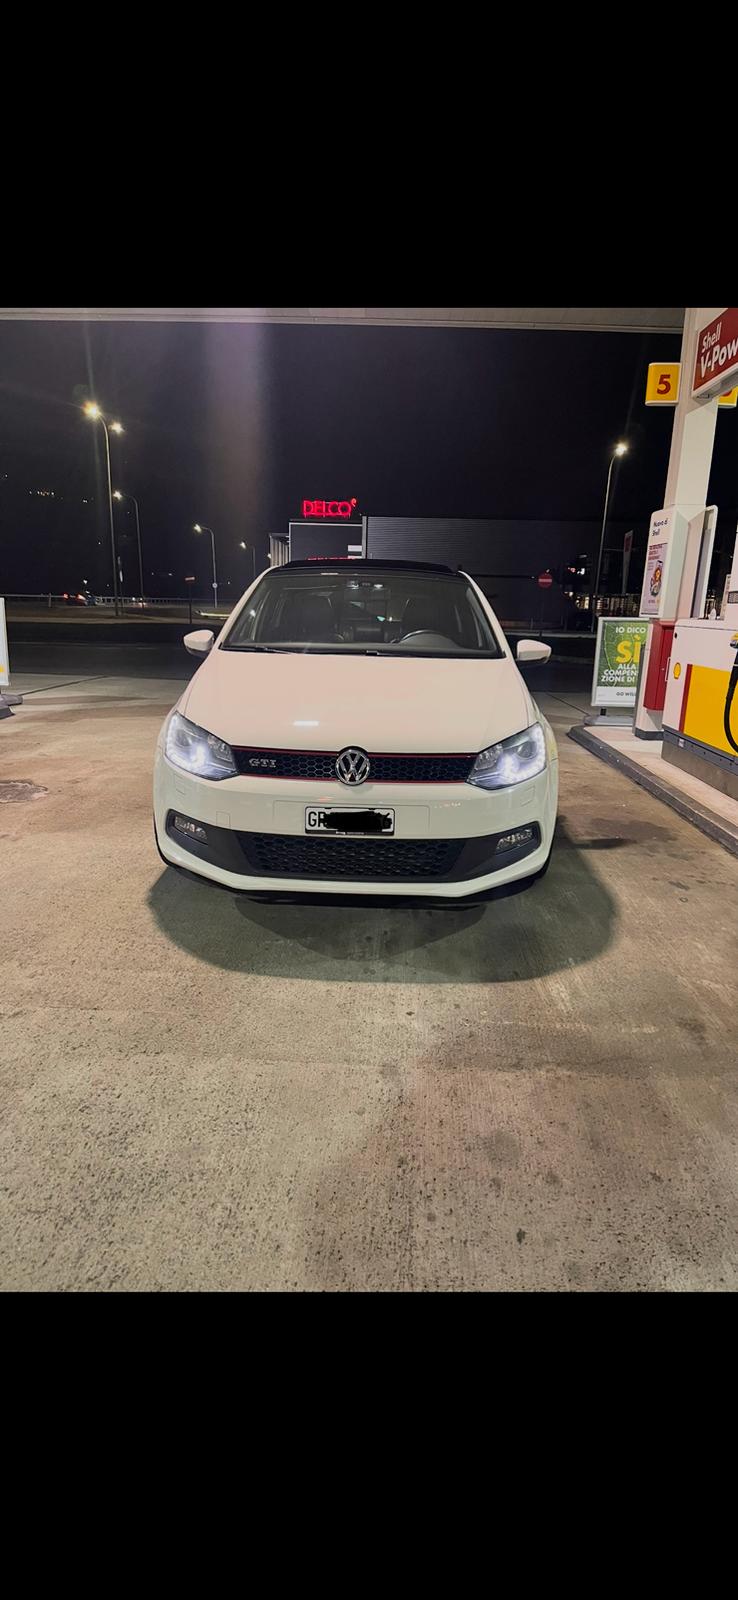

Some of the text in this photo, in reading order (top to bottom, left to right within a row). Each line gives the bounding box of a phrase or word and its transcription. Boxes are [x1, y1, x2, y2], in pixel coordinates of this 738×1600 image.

[702, 322, 722, 353] Shell
[656, 374, 671, 395] 5
[303, 500, 352, 516] DELCO
[615, 626, 646, 634] IO DICO
[603, 669, 639, 677] COMPEN
[601, 675, 635, 683] ZIONE DI
[248, 758, 277, 768] GTI
